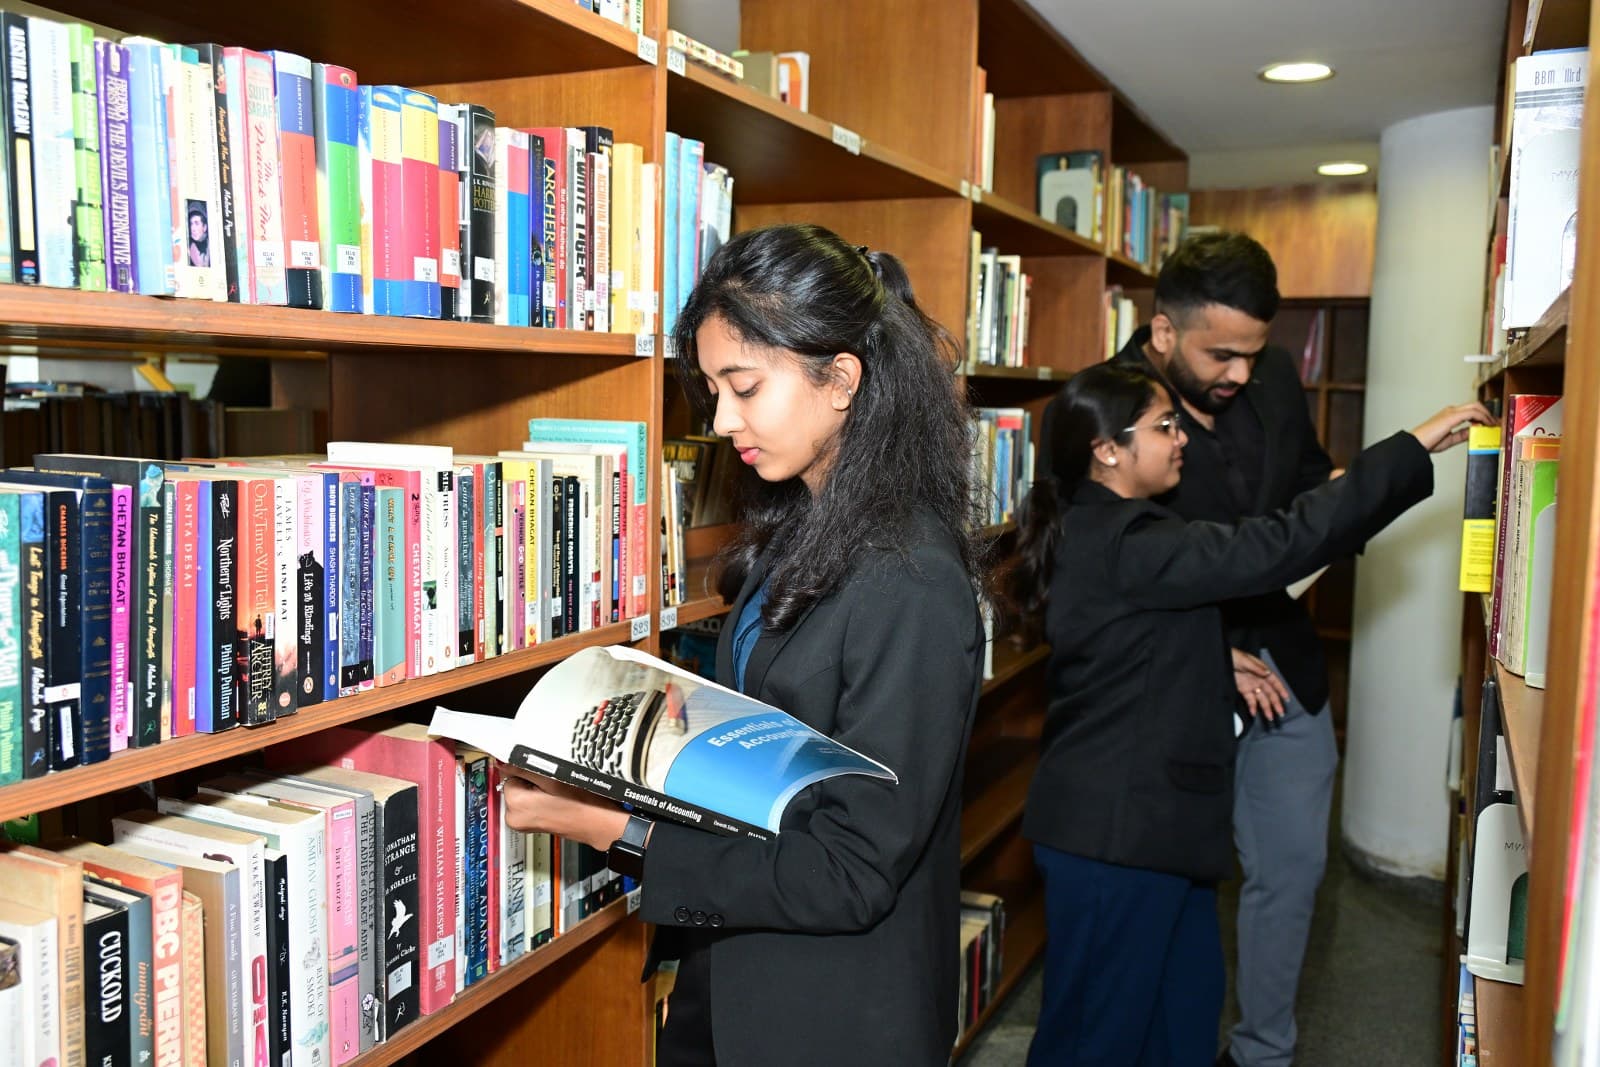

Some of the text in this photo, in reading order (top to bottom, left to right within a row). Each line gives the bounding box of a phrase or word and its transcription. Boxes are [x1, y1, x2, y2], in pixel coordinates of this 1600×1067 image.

[109, 122, 128, 145] THE
[254, 123, 268, 199] Peacock
[544, 164, 556, 242] ARCHER
[558, 188, 566, 202] But
[558, 204, 566, 224] other
[112, 192, 131, 265] ALTERNATIVE
[597, 172, 608, 274] ACCIDENTAL APPRENTICE
[559, 260, 566, 270] do
[576, 222, 587, 278] TIGER
[148, 513, 158, 525] The
[412, 493, 420, 501] 2
[442, 471, 450, 528] MISTRESS
[184, 494, 193, 588] ANITA DESAI
[285, 500, 293, 542] JAMES
[30, 546, 43, 567] Last
[60, 538, 68, 570] DICKENS
[116, 494, 127, 604] CHETAN BHAGAT
[252, 483, 268, 610] Only Time Will Tell
[28, 570, 42, 595] Tango
[60, 574, 68, 590] Great
[164, 560, 172, 586] SHOBHA
[216, 538, 234, 620] Northern Lights
[304, 572, 314, 590] Life
[412, 543, 420, 635] CHETAN BHAGAT
[60, 591, 68, 628] Expectations
[300, 604, 314, 644] Blandings
[632, 620, 648, 636] 823
[218, 643, 232, 720] Philip Pullman
[251, 640, 265, 701] ARCHER
[262, 644, 272, 691] JEFFREY
[707, 720, 784, 748] Essentials
[436, 772, 444, 798] Complete
[594, 778, 612, 790] Anthony
[624, 788, 702, 823] Essentials of Accounting
[384, 844, 416, 866] STRANGE
[436, 826, 444, 878] WILLIAM
[252, 853, 261, 938] VIKAS SWARUP
[306, 836, 318, 935] AMITAV GHOSH
[335, 848, 344, 912] hari kunzru
[360, 812, 370, 962] THE LADIES GRACE ADIEU
[479, 806, 488, 952] DOUGLAS ADAMS
[436, 880, 445, 937] SHAKESPE
[64, 948, 81, 982] ELEVEN
[228, 933, 238, 961] Family
[40, 936, 50, 1038] VIKAS SWARUP
[98, 930, 122, 1023] CUCKOLD
[156, 885, 182, 1067] DBC PIERR
[306, 977, 316, 1018] SMOKE
[316, 966, 325, 1018] RIVER OF
[66, 986, 81, 1025] STORIES
[134, 962, 150, 1037] immigrant
[280, 1009, 288, 1042] Narayan
